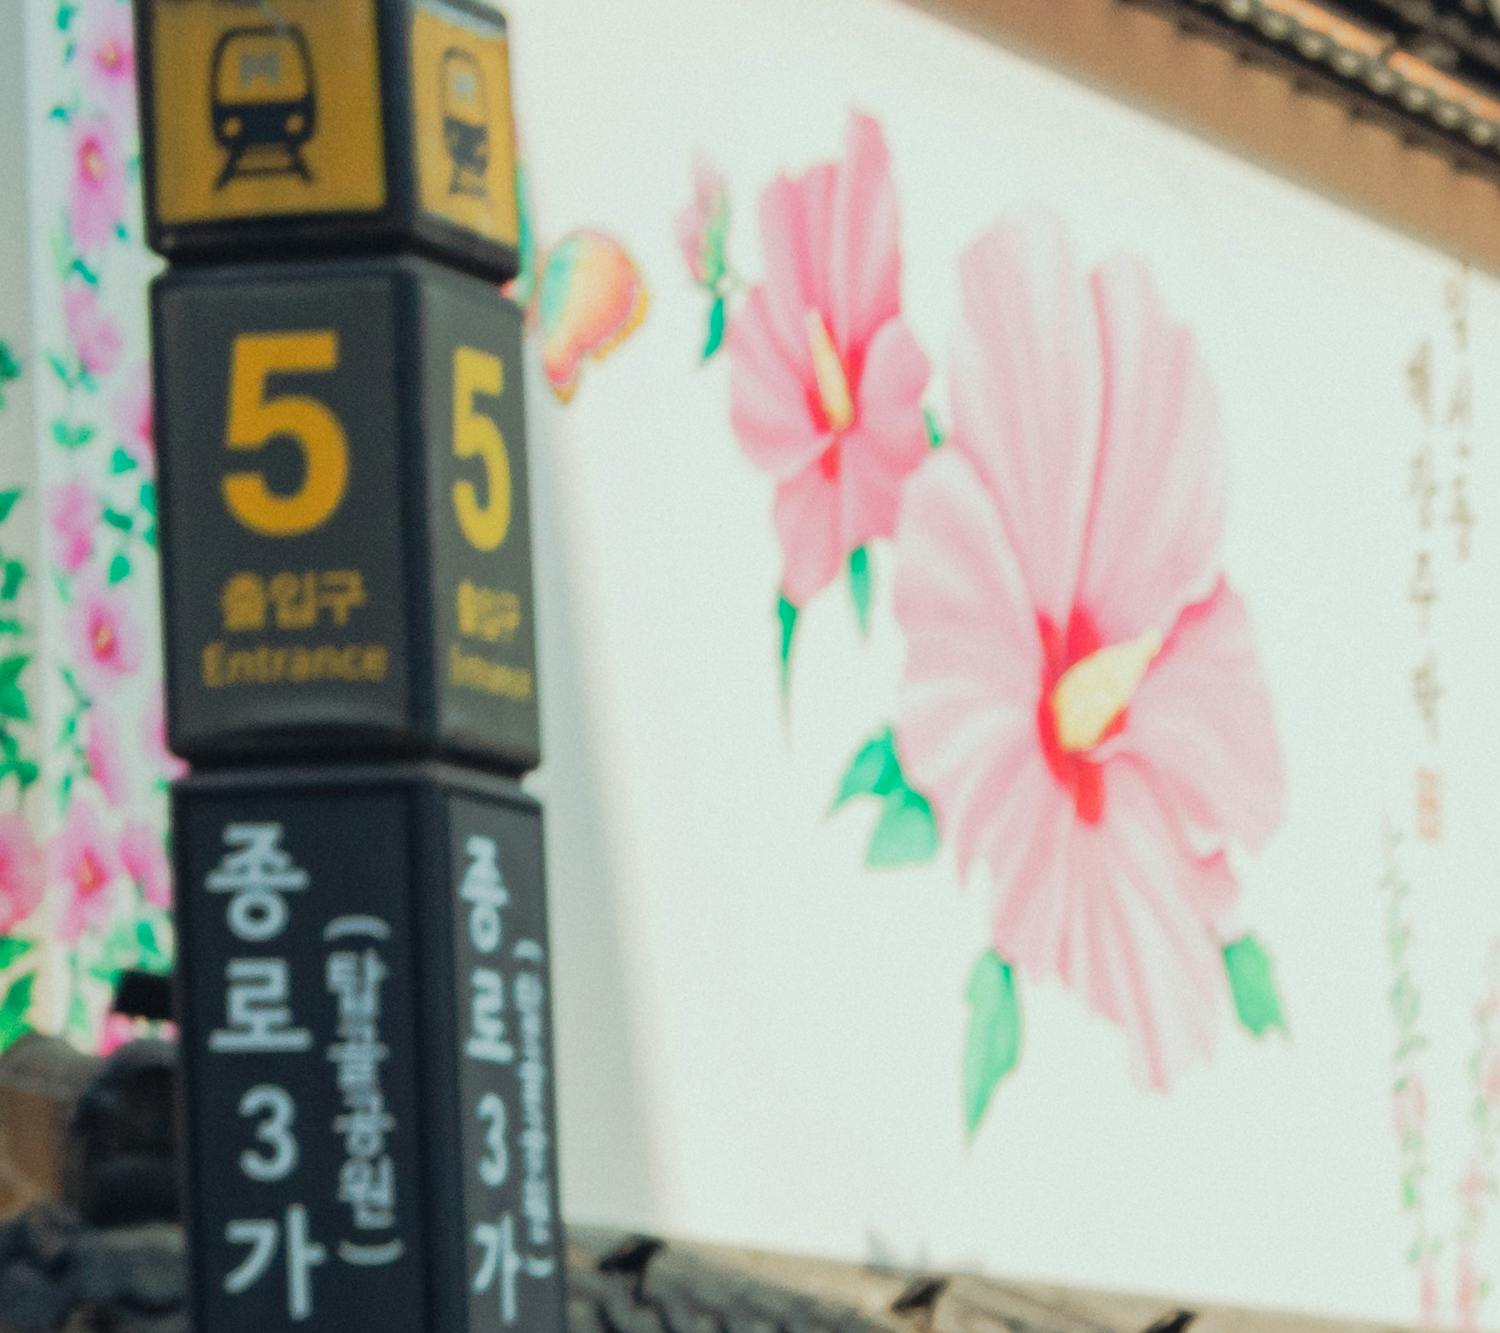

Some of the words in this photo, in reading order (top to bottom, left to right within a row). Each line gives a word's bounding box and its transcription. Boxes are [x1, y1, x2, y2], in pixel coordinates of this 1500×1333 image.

[223, 330, 350, 537] 5
[450, 346, 512, 553] 5
[203, 644, 389, 689] Entrance
[204, 821, 327, 1321] 종로3가
